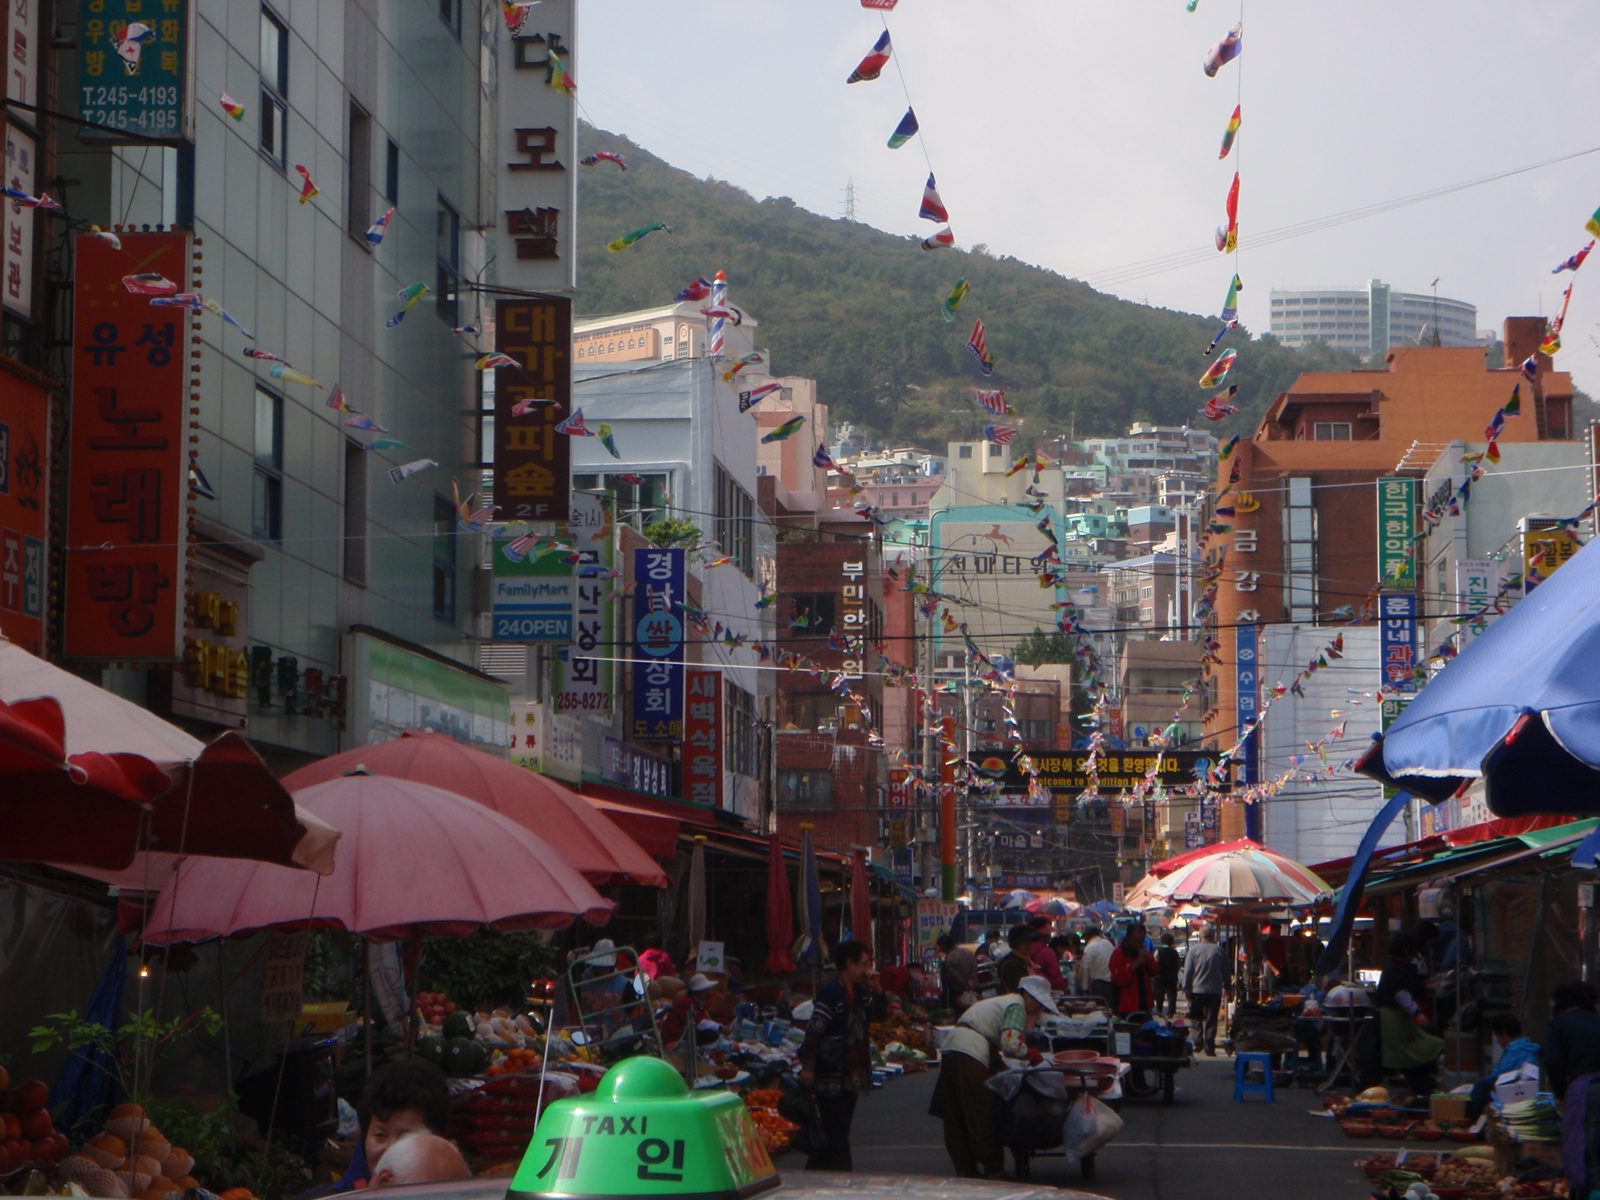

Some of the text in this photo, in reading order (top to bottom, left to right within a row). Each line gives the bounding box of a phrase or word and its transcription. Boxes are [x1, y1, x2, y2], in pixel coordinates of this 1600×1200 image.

[83, 87, 177, 105] T.245-4193
[84, 322, 175, 367] 유성
[85, 384, 169, 638] 노래방
[516, 503, 550, 517] 2F
[498, 583, 569, 598] FamilyMart
[556, 692, 609, 710] 255-8272
[1076, 757, 1116, 774] 오것을
[1031, 776, 1071, 787] elcome
[583, 1116, 647, 1135] TAXI
[536, 1137, 685, 1182] 개인
